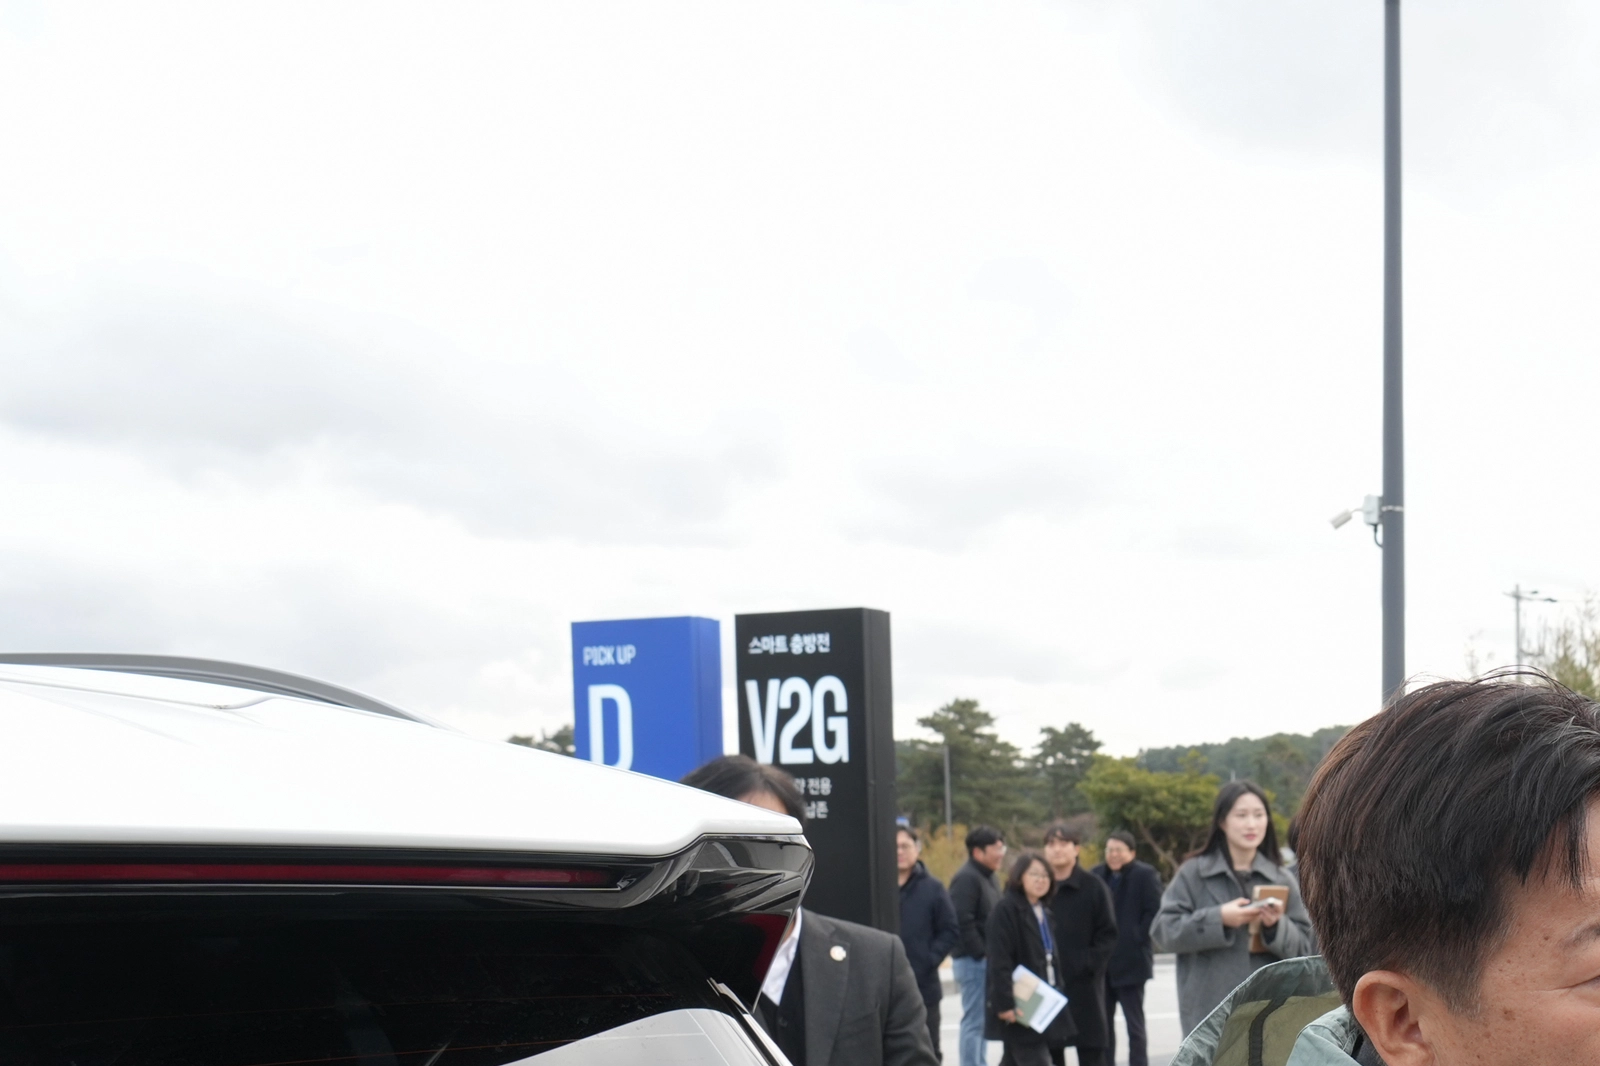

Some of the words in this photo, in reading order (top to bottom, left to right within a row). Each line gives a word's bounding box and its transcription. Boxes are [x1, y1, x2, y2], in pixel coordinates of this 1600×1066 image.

[583, 645, 616, 666] PICK
[616, 644, 636, 665] UP
[748, 634, 789, 655] 스마트
[790, 631, 831, 655] 충방전
[588, 684, 634, 771] D
[745, 675, 850, 765] V2G
[807, 776, 832, 796] 전용
